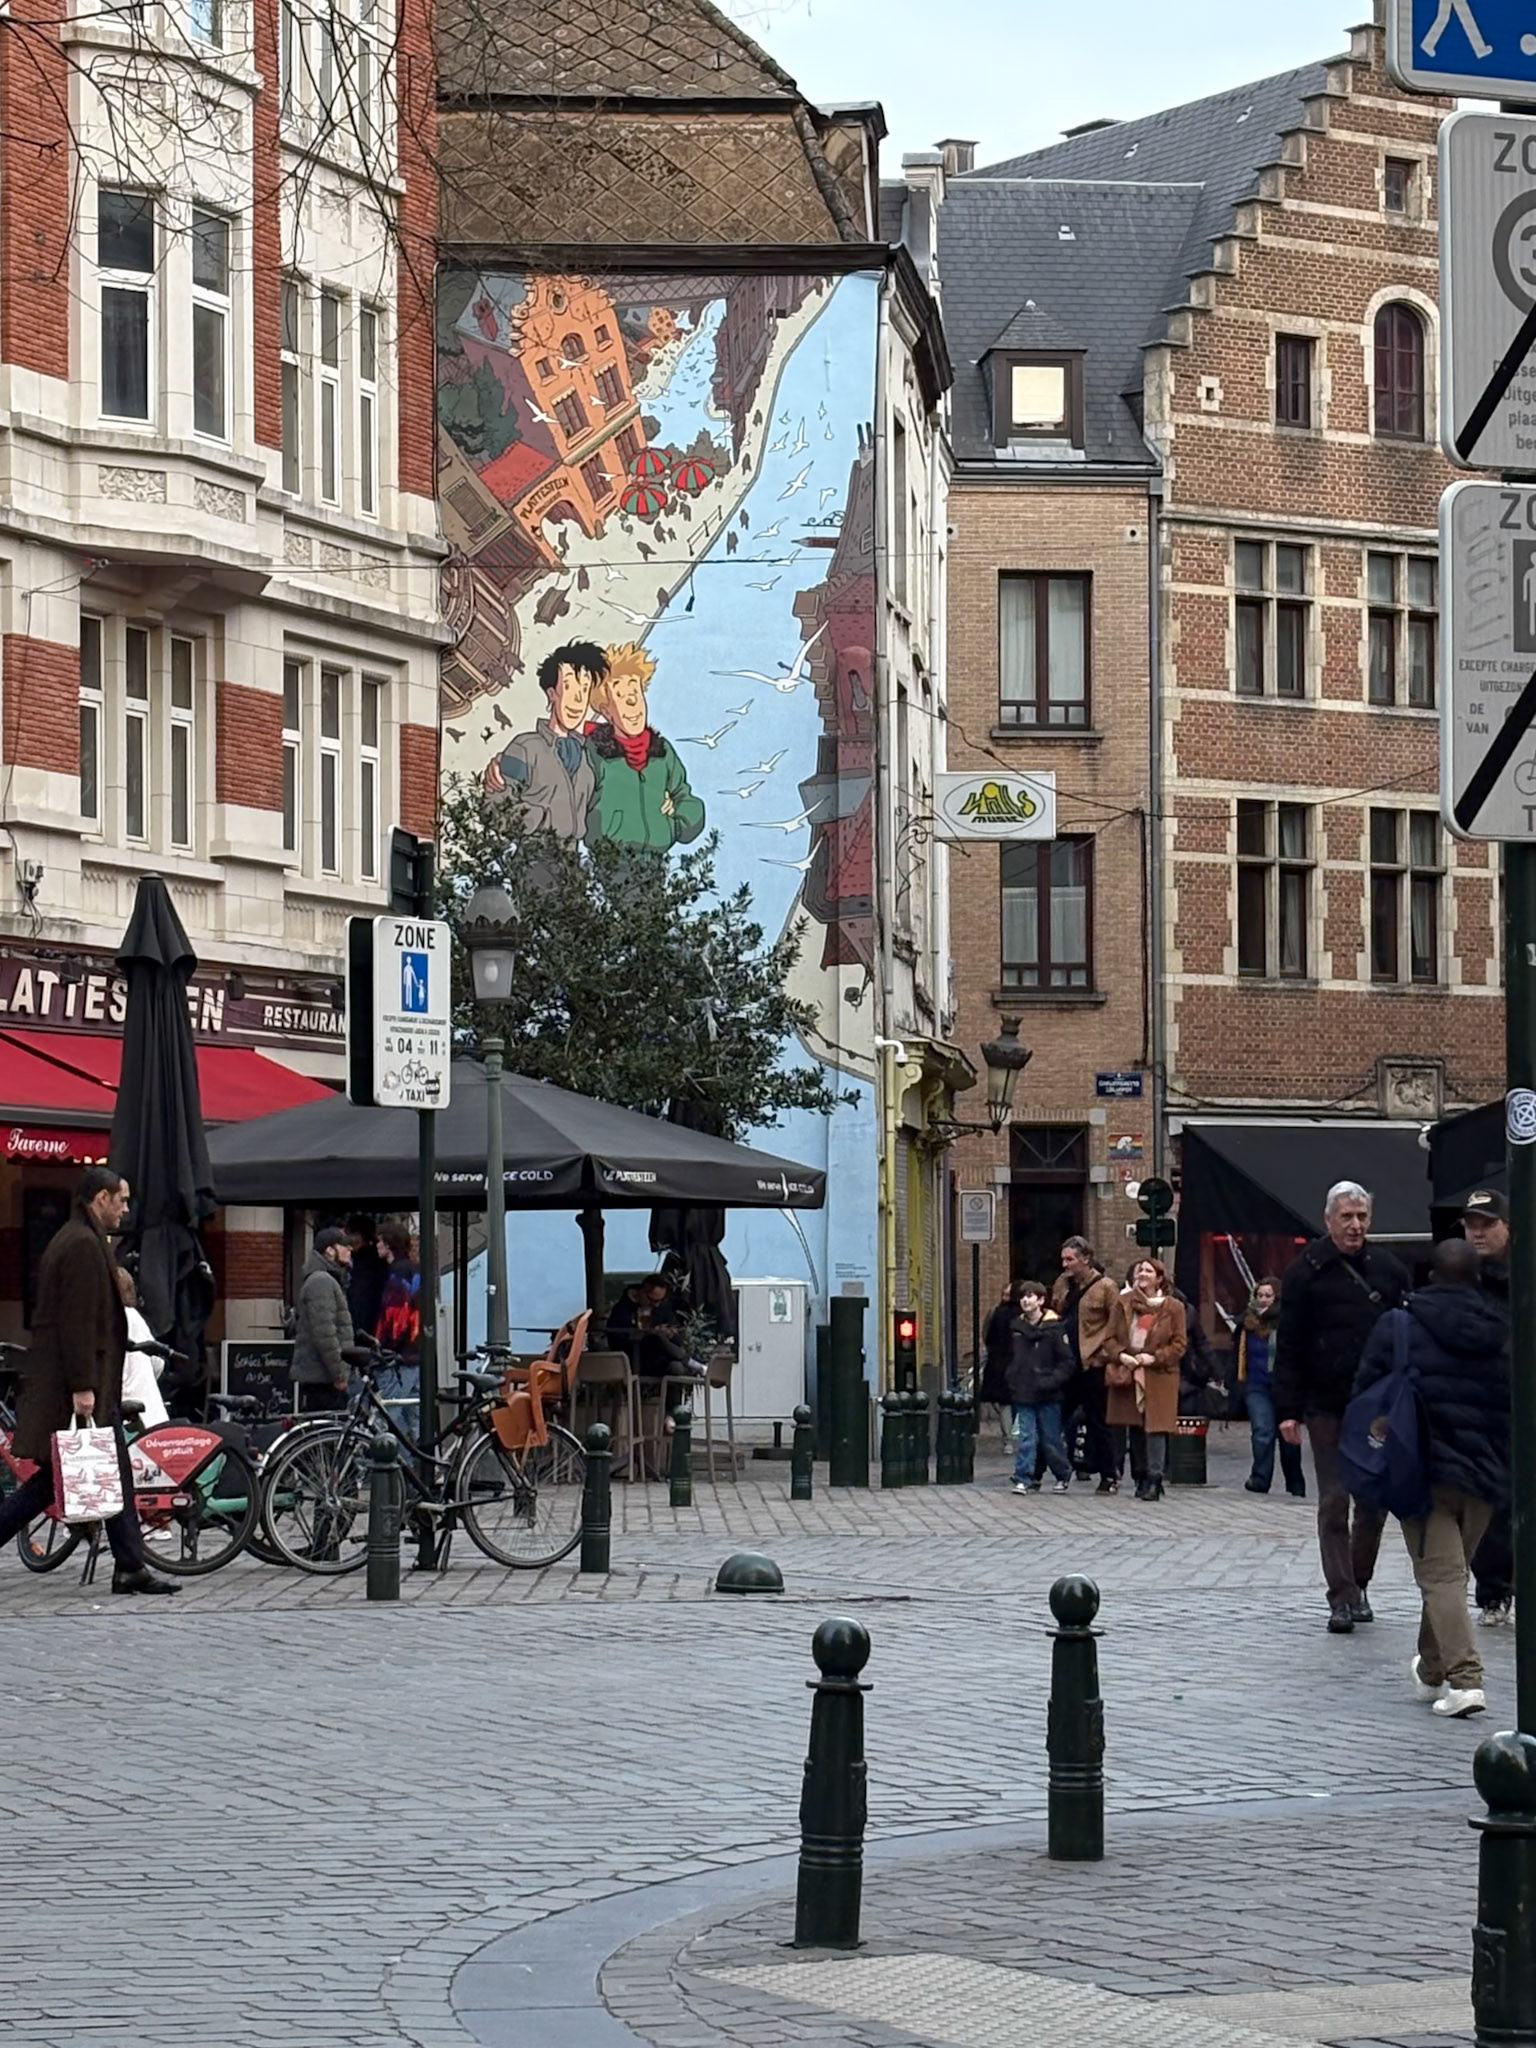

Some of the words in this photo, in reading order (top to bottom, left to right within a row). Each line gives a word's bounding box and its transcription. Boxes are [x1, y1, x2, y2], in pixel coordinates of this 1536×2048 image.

[1469, 703, 1485, 715] DE
[1466, 722, 1489, 734] VAN
[394, 925, 436, 949] ZONE
[397, 1037, 413, 1054] 04
[405, 1089, 425, 1102] TAXI
[7, 1128, 70, 1153] Taverne
[451, 1173, 483, 1181] serve
[519, 1170, 553, 1180] COLD
